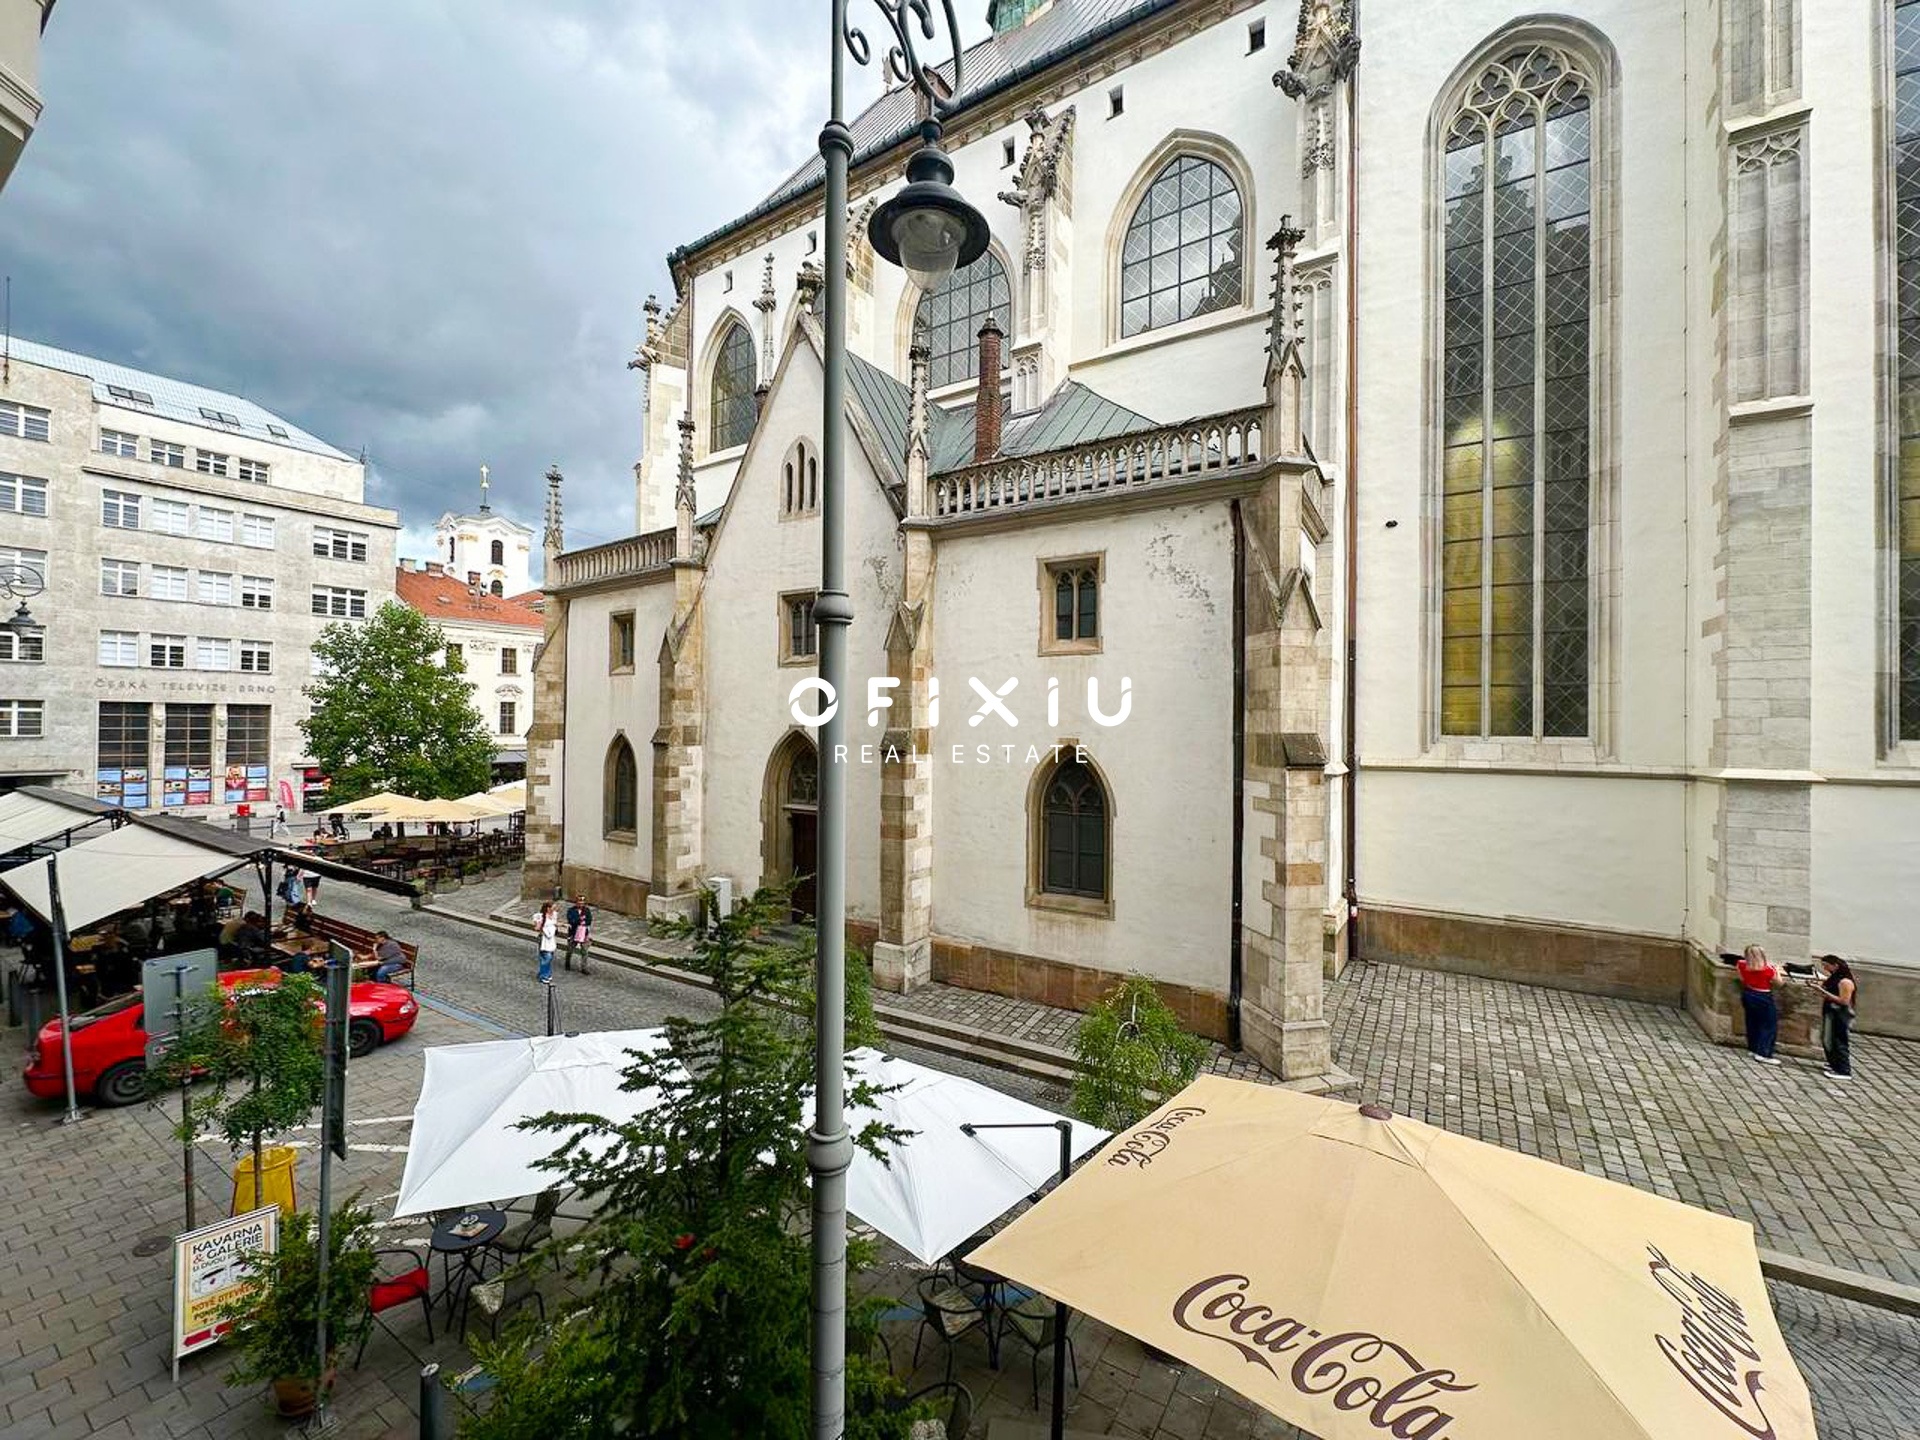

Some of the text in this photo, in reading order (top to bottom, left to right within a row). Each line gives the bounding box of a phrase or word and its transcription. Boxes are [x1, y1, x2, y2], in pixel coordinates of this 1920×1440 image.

[161, 681, 228, 693] TELEVIZE
[239, 684, 276, 694] BRNO
[1108, 1107, 1206, 1169] Coca-Cola
[206, 1232, 263, 1259] GALERIE
[1173, 1274, 1478, 1440] Coca-Cola
